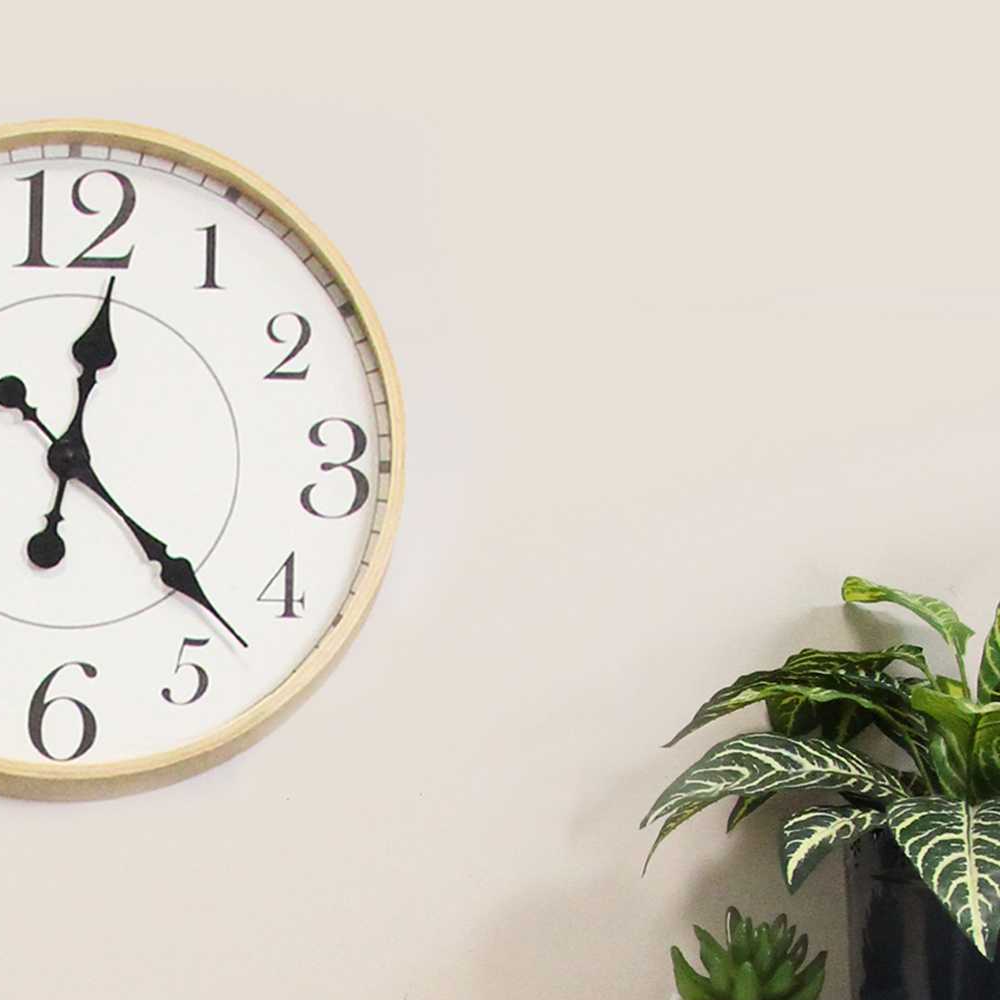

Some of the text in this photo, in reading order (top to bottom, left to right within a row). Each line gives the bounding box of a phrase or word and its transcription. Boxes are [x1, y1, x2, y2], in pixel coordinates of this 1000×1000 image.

[13, 169, 136, 269] 12
[196, 223, 225, 289] 1
[263, 313, 311, 380] 2
[299, 417, 370, 519] 3
[256, 551, 306, 618] 4
[161, 637, 212, 706] 5
[28, 661, 97, 761] 6
